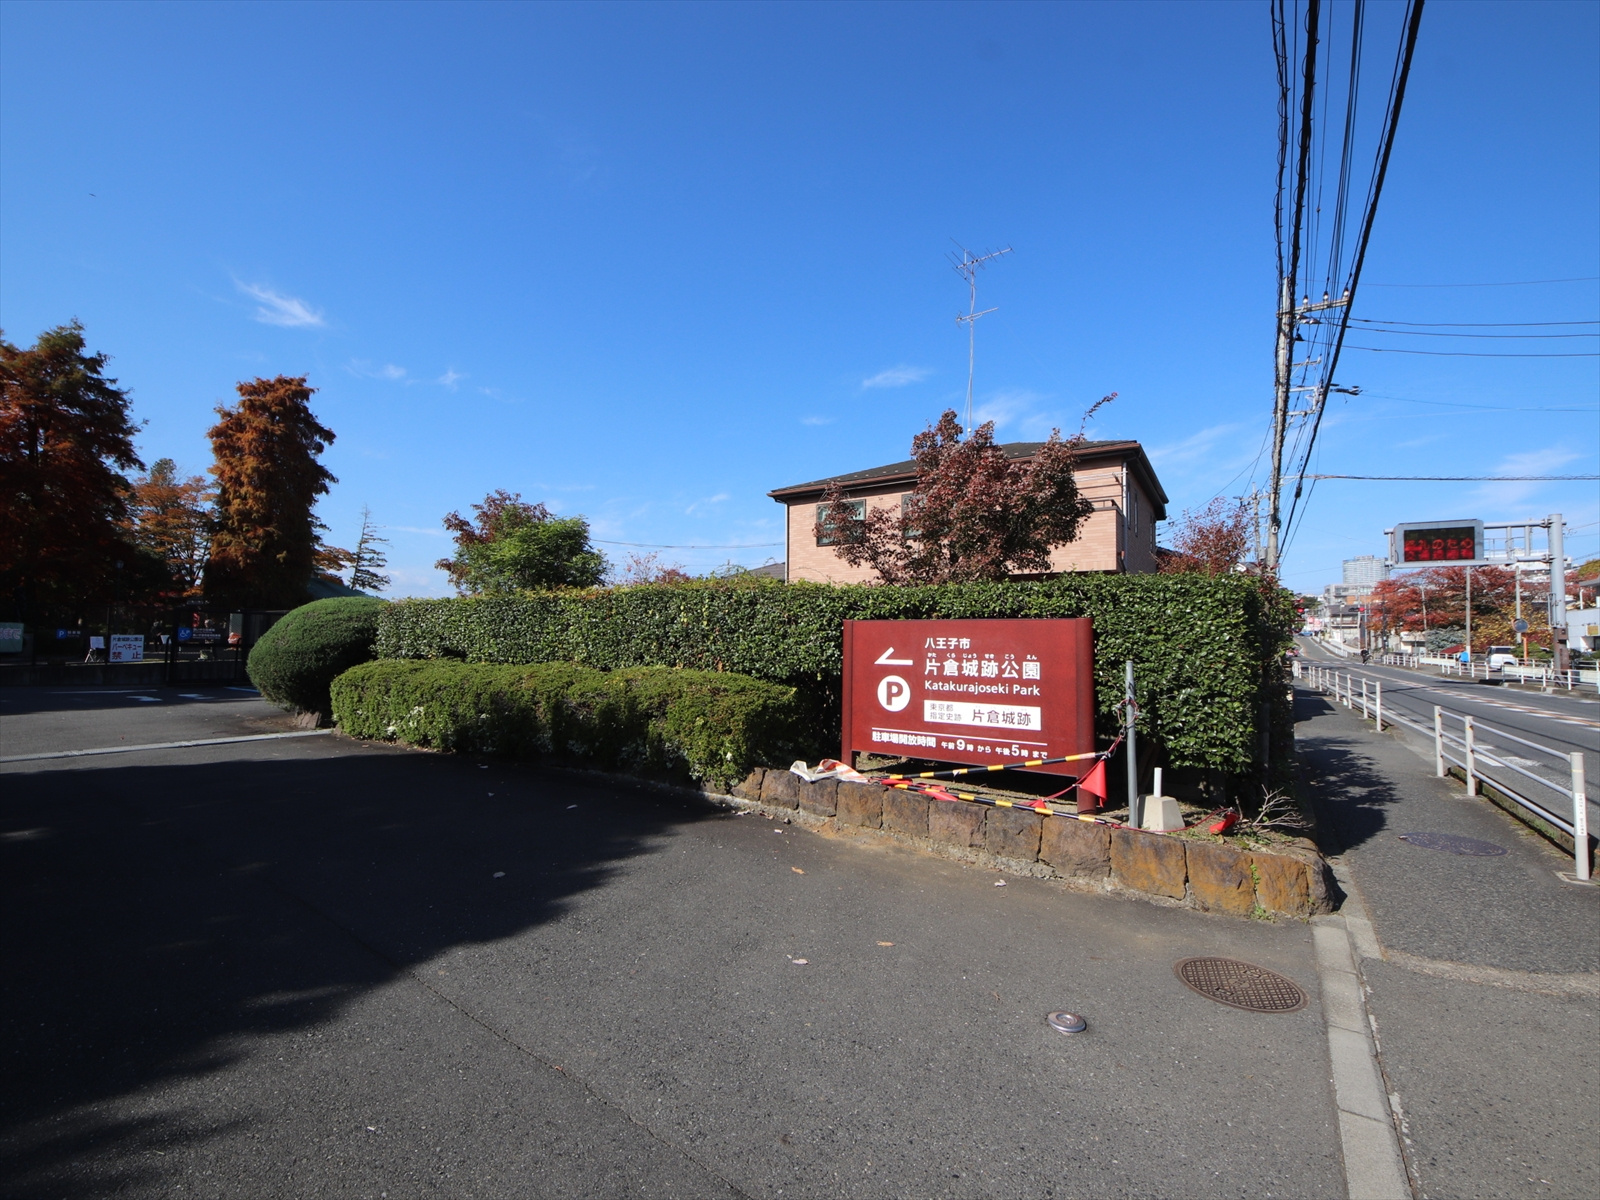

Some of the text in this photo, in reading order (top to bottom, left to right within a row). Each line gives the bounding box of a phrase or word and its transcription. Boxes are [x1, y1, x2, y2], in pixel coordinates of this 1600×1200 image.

[112, 643, 142, 651] バーベキュー
[924, 637, 971, 650] 八王子市
[924, 658, 1041, 680] 片倉城跡公園
[886, 681, 904, 706] P
[924, 680, 1041, 697] Katakurajoseki Park
[929, 703, 954, 712] 東京都
[929, 712, 962, 722] 指定史跡
[972, 709, 1032, 727] 片倉城跡
[872, 731, 1048, 760] 駐車場開放時間 午前9時 から 午後5時 まで
